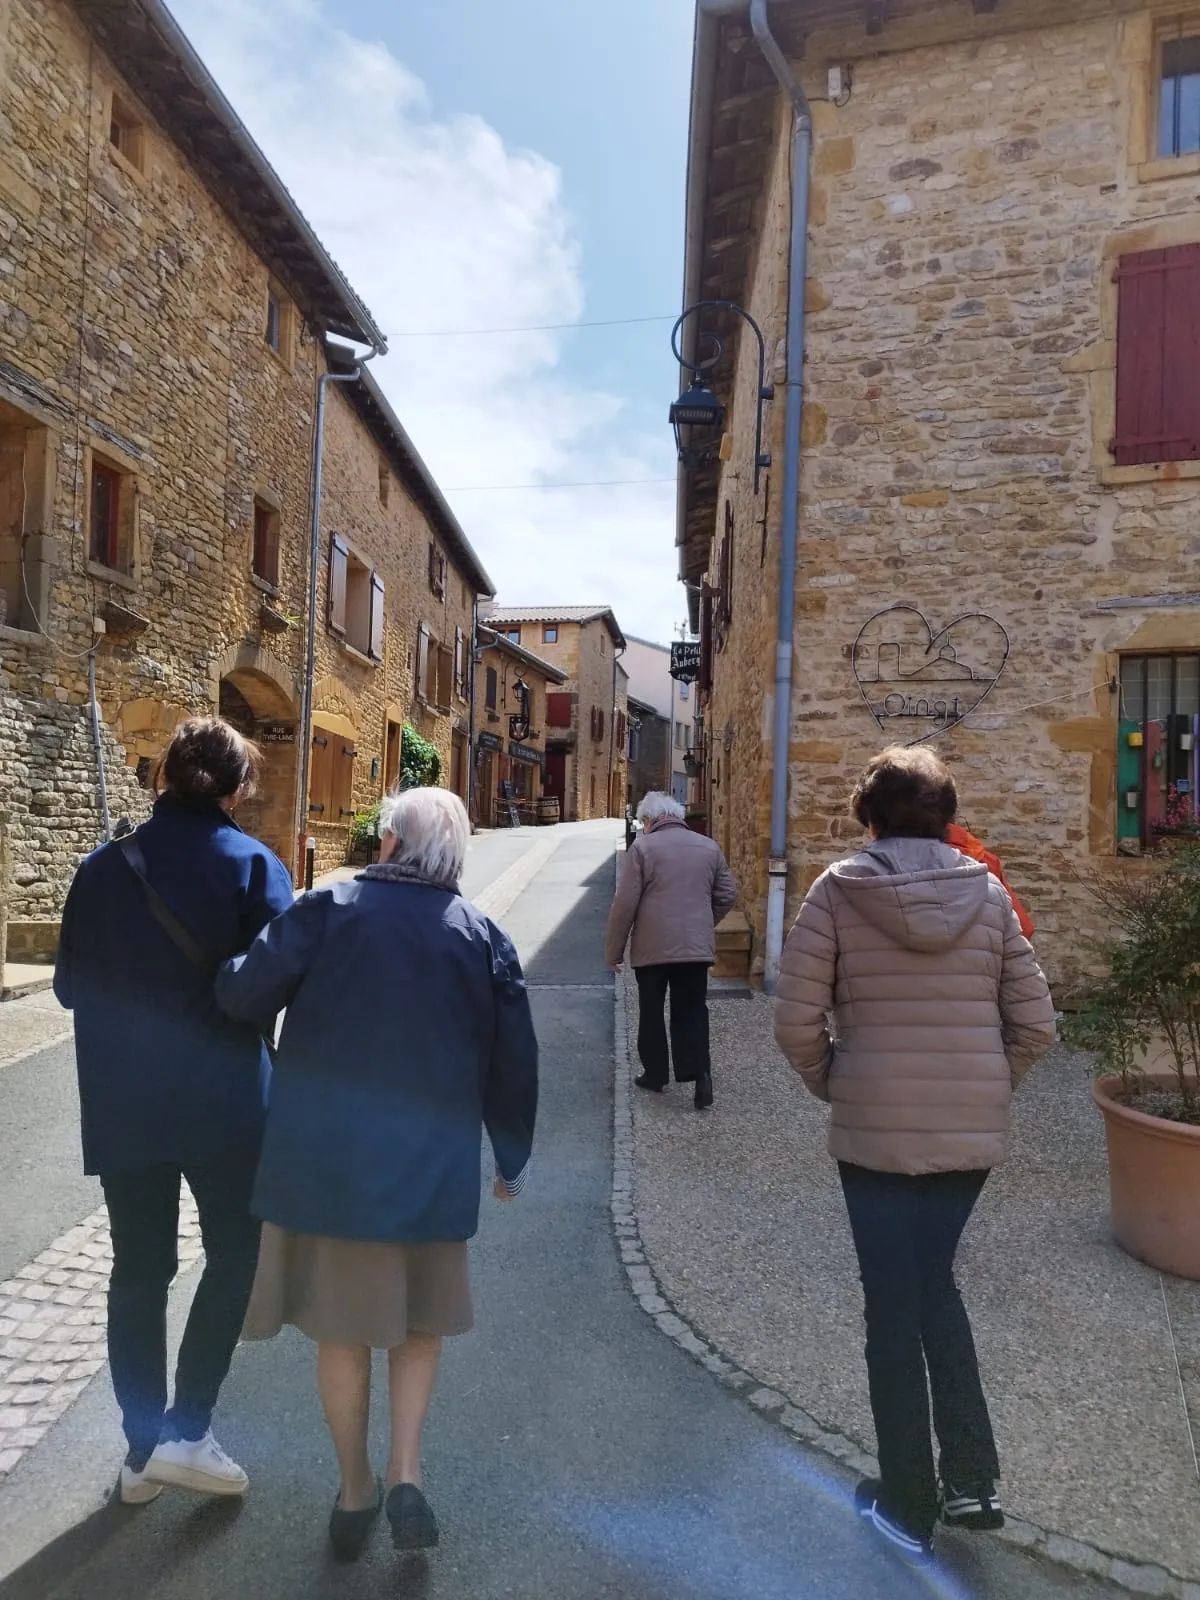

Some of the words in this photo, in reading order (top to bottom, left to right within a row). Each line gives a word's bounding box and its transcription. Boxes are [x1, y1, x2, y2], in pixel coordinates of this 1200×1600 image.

[684, 646, 701, 655] Petit
[671, 655, 701, 668] Auberg
[884, 693, 960, 726] Oingt
